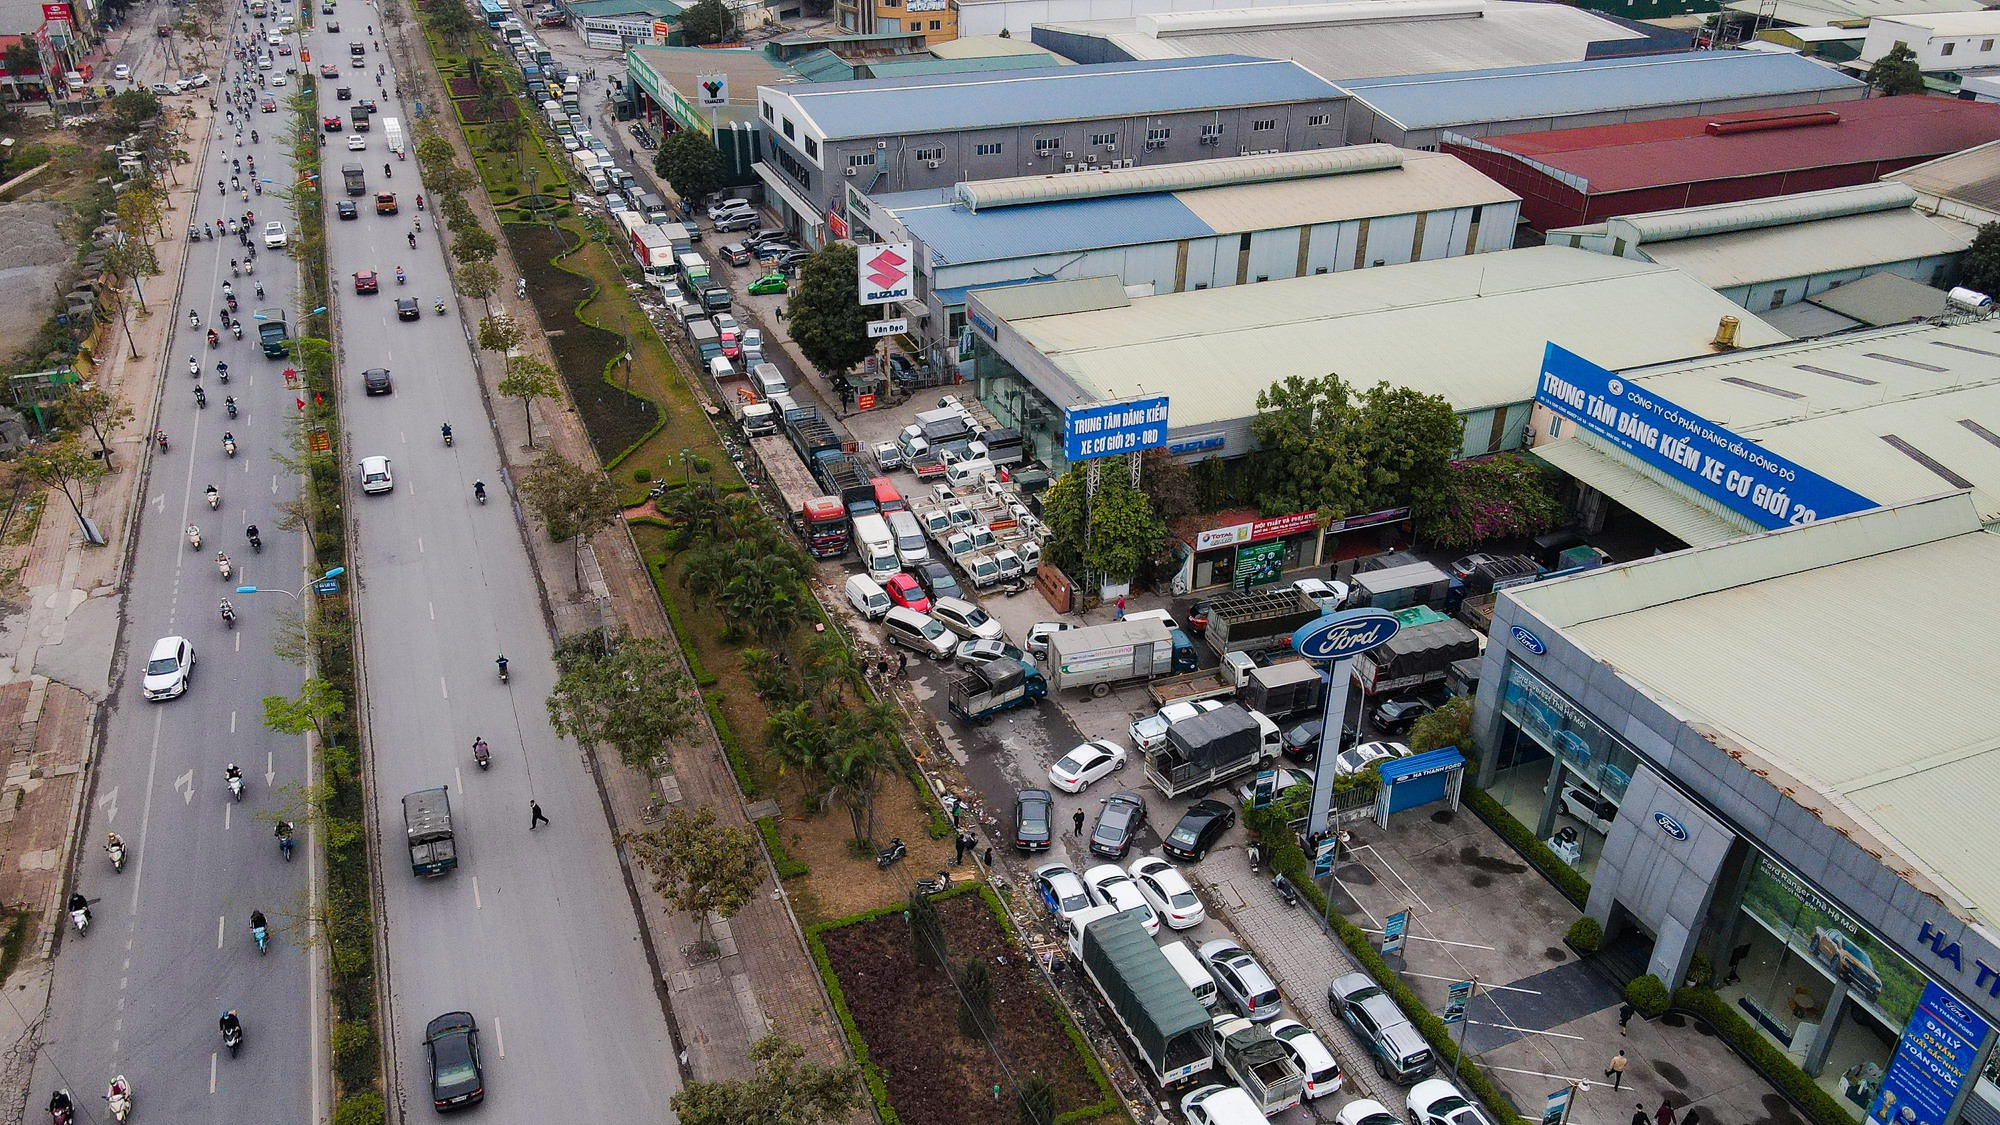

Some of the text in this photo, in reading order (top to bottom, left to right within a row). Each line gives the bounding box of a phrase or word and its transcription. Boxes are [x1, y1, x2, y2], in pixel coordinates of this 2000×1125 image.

[868, 289, 908, 300] SUZUKI
[1075, 402, 1168, 434] TRUNG TÂM ĐĂNG KIỂM
[1080, 440, 1092, 456] XE
[1094, 436, 1106, 453] CƠ
[1107, 432, 1123, 451] GIỚI
[1124, 433, 1136, 448] 29
[1142, 429, 1158, 444] 08D
[1169, 436, 1225, 454] SUZUKI
[1543, 372, 1586, 410] TRUNG
[1586, 395, 1618, 428] TÂM
[1618, 412, 1660, 450] ĐĂNG
[1659, 434, 1702, 472] KIỂM
[1700, 456, 1726, 485] XE
[1726, 470, 1754, 498] CƠ
[1752, 487, 1791, 520] GIỚI
[1627, 392, 1652, 410] CÔNG
[1654, 404, 1664, 416] TY
[1664, 410, 1678, 422] CỔ
[1702, 430, 1728, 448] ĐĂNG
[1728, 442, 1749, 459] KIỂM
[1749, 453, 1778, 474] ĐÔNG
[1319, 622, 1381, 654] Ford
[1516, 631, 1537, 650] Ford
[1515, 670, 1529, 684] Ford
[1444, 762, 1462, 771] FORD
[1659, 817, 1680, 835] Ford
[1762, 858, 1780, 876] Ford
[1781, 872, 1810, 898] Ranger
[1828, 907, 1840, 922] Hệ
[1840, 918, 1858, 935] Mới
[1918, 920, 1963, 972] HA
[1939, 1008, 1958, 1026] THANH
[1946, 1002, 1966, 1018] Ford
[1926, 1020, 1962, 1050] ĐẠI LÝ
[1905, 1041, 1958, 1088] TOÀN QUỐC
